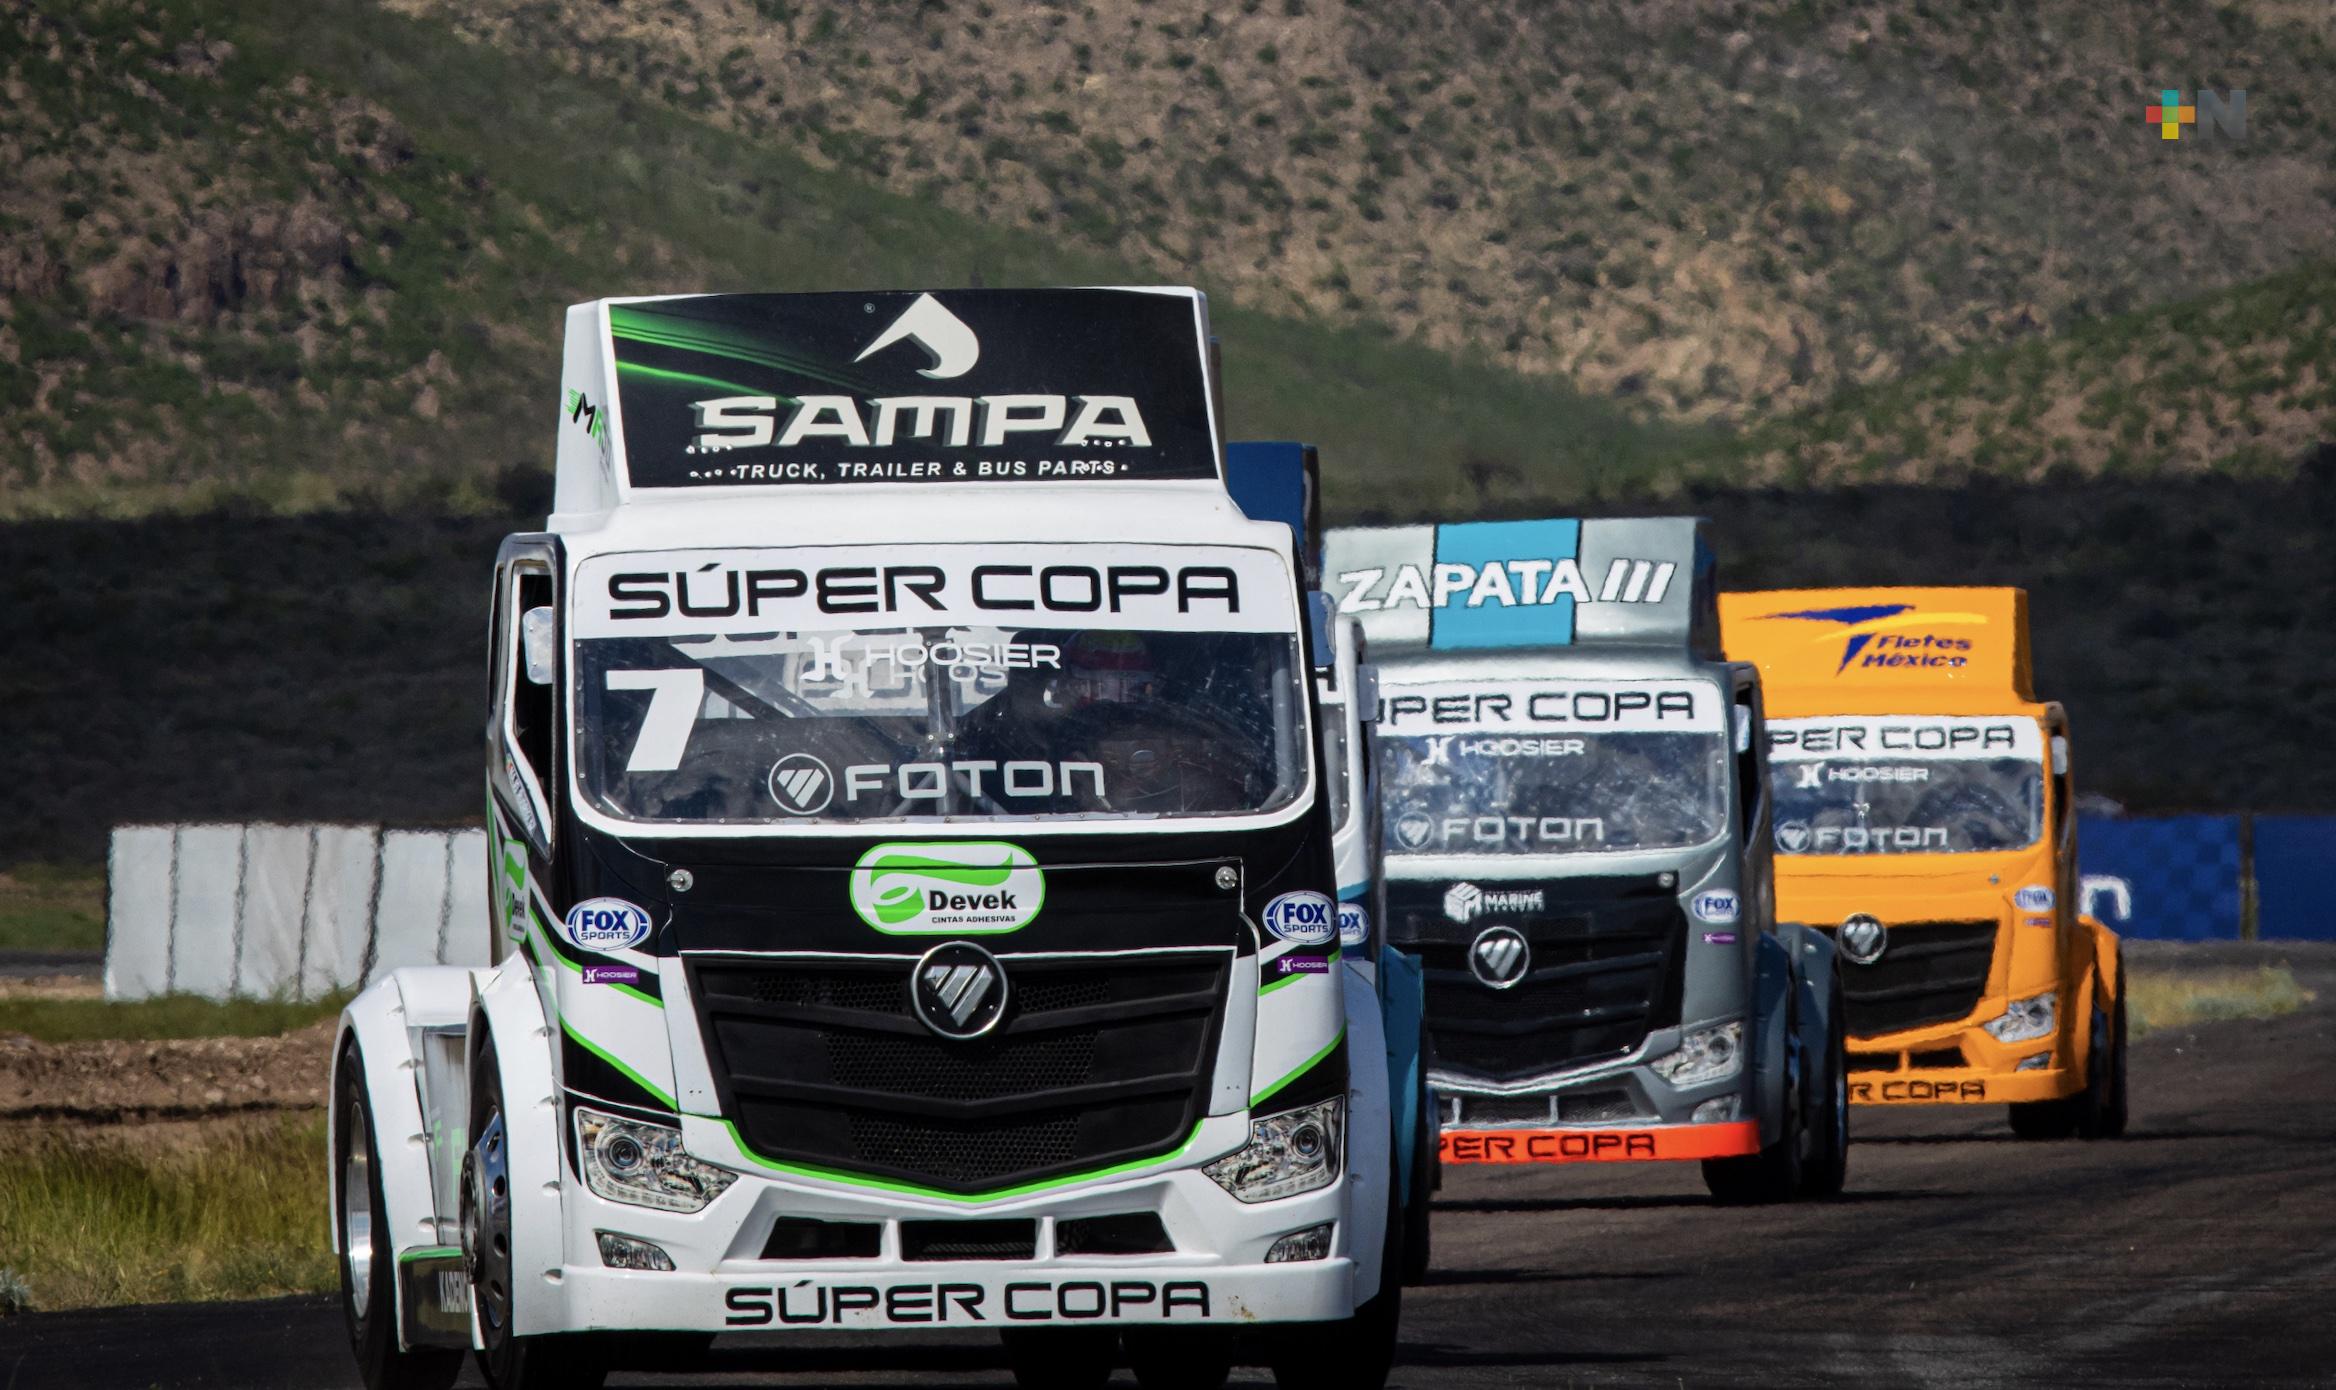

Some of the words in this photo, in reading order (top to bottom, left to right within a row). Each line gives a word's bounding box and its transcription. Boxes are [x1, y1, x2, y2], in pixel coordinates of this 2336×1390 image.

[688, 395, 1152, 447] SAMPA
[737, 463, 826, 480] TRUCK,
[838, 461, 942, 477] TRAILER
[952, 461, 968, 476] &
[978, 460, 1027, 476] BUS
[1038, 459, 1116, 475] PARTS
[608, 562, 948, 620] SÚPER
[971, 565, 1240, 613] COPA
[1338, 558, 1593, 613] ZAPATA
[865, 642, 1062, 670] HOOSIER
[1528, 691, 1695, 722] COPA
[605, 668, 704, 771] 7
[1460, 739, 1585, 756] HOOSIER
[1881, 725, 2015, 750] COPA
[845, 760, 1106, 800] FOTON
[1828, 767, 1929, 781] HOOSIER
[1442, 816, 1604, 841] FOTON
[1815, 827, 1949, 848] FOTON
[929, 889, 1018, 912] Devek
[1704, 896, 1734, 910] FOX
[581, 910, 630, 932] FOX
[931, 915, 964, 924] CINTAS
[966, 915, 1016, 924] ADHESIVAS
[1283, 902, 1328, 924] FOX
[580, 931, 631, 941] SPORTS
[1284, 923, 1329, 934] SPORTS
[1882, 1078, 1986, 1101] COPA
[1527, 1133, 1656, 1158] COPA
[725, 1280, 985, 1326] SÚPER
[1004, 1281, 1211, 1319] COPA
